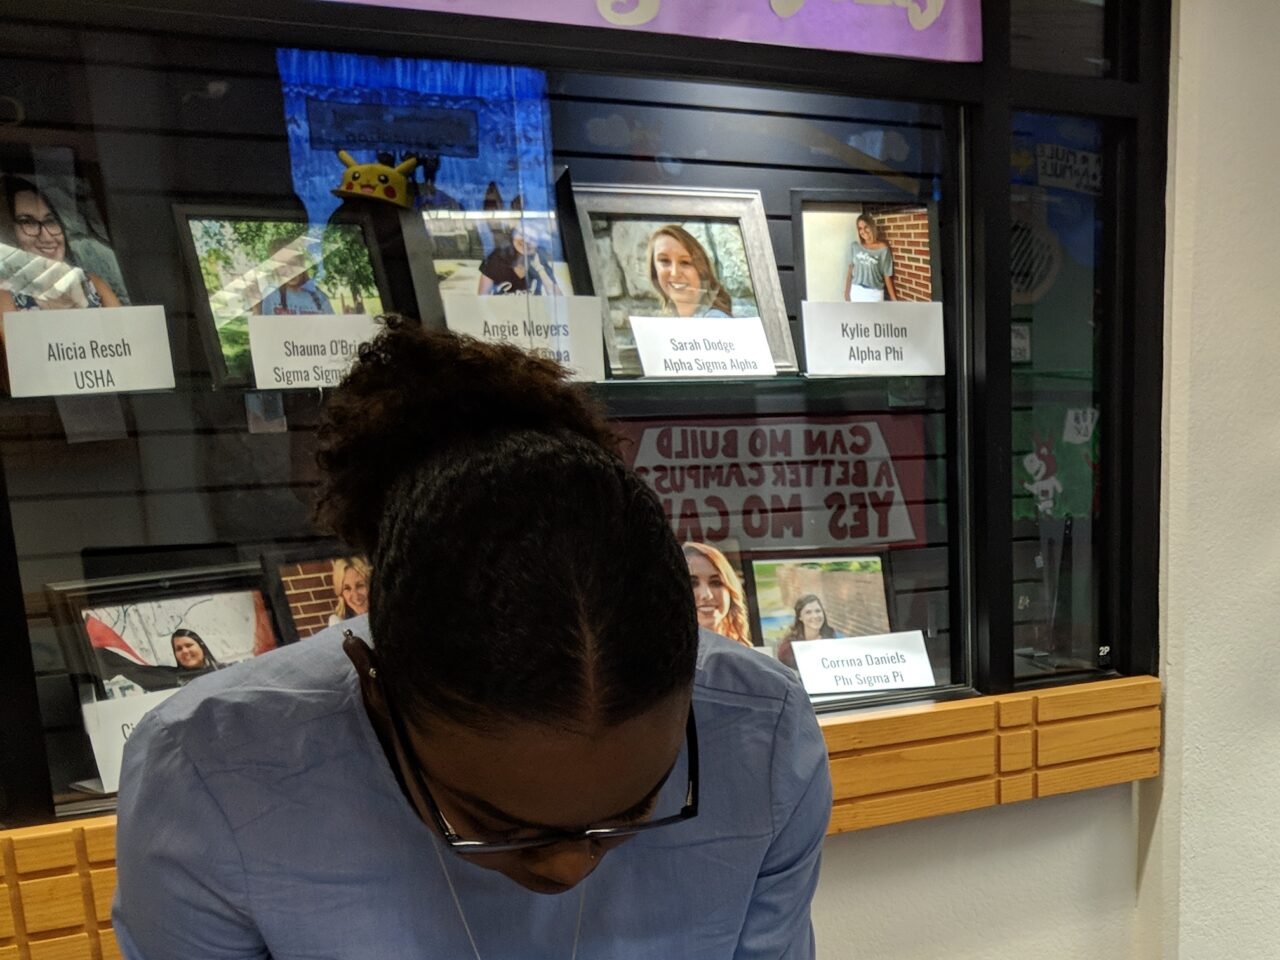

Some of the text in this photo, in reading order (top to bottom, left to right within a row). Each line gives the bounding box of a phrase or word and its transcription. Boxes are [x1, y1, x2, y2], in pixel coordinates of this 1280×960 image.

[483, 320, 570, 340] Angie Meyers
[841, 322, 908, 340] Kylie Dillon
[47, 338, 132, 362] Alicia Resch
[284, 340, 327, 357] Shauna
[669, 338, 735, 353] Sarah Dodge
[848, 346, 904, 364] Alpha Phi
[663, 358, 759, 373] Alpha Sigma Alpha
[74, 369, 116, 390] USHA
[273, 366, 310, 385] Sigma
[821, 652, 907, 670] Corrina Daniels
[834, 671, 905, 688] Phi Sigma Pi
